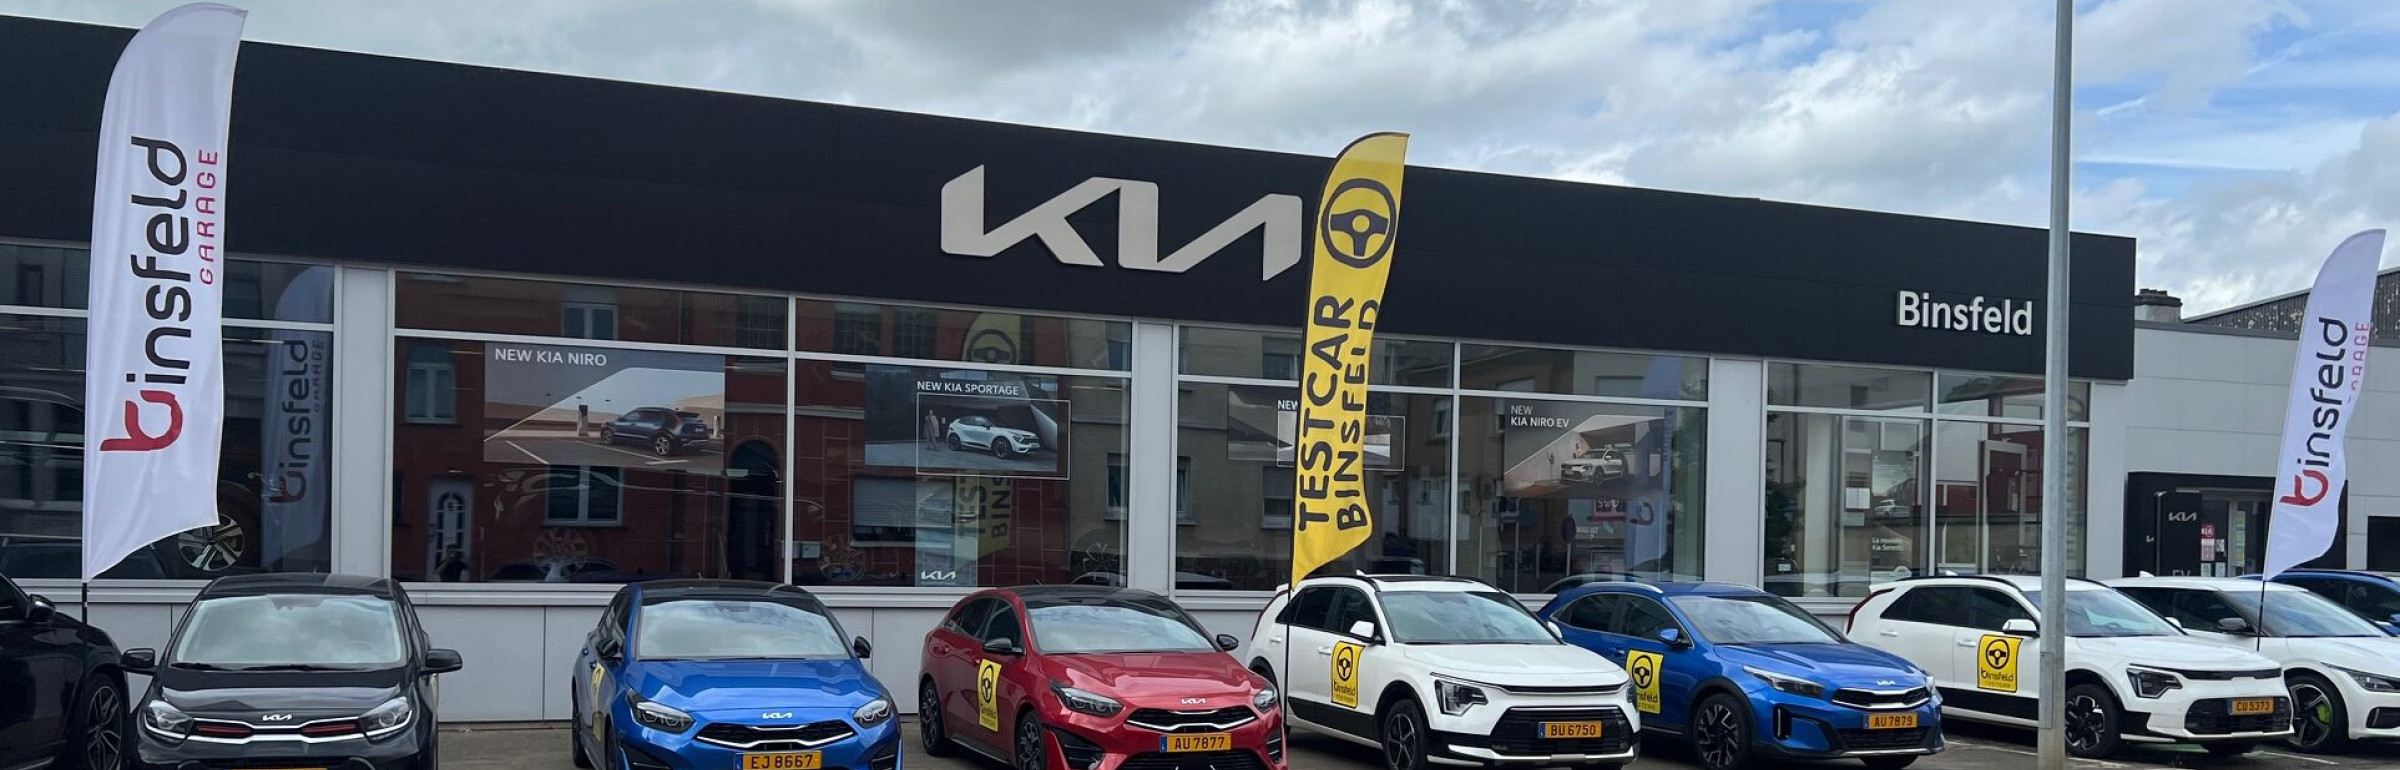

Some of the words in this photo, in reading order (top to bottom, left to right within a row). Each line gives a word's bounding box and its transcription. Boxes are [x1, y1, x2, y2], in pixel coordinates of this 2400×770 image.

[196, 149, 218, 285] GARAGE
[941, 164, 1303, 281] KIA
[1897, 290, 2033, 335] Binsfeld
[495, 348, 532, 362] NEW
[536, 350, 563, 364] KIA
[568, 352, 607, 366] NIRO
[917, 380, 942, 391] NEW
[944, 382, 962, 392] KIA
[965, 383, 1019, 395] SPORTAGE
[1299, 294, 1355, 532] TESTCAR
[1333, 299, 1379, 532] BINSFELD
[1510, 405, 1533, 415] NEW
[1510, 416, 1528, 426] KIA
[1530, 417, 1555, 427] NIRO
[1556, 418, 1570, 428] EV
[2168, 512, 2197, 521] KIA
[920, 570, 956, 580] KIA
[1874, 716, 1887, 727] AU
[1889, 716, 1913, 726] 7879
[1551, 725, 1566, 736] BU
[1568, 724, 1597, 736] 6750
[1174, 737, 1190, 749] AU
[1194, 737, 1225, 749] 7877
[751, 756, 770, 769] EJ
[775, 754, 813, 769] 8667
